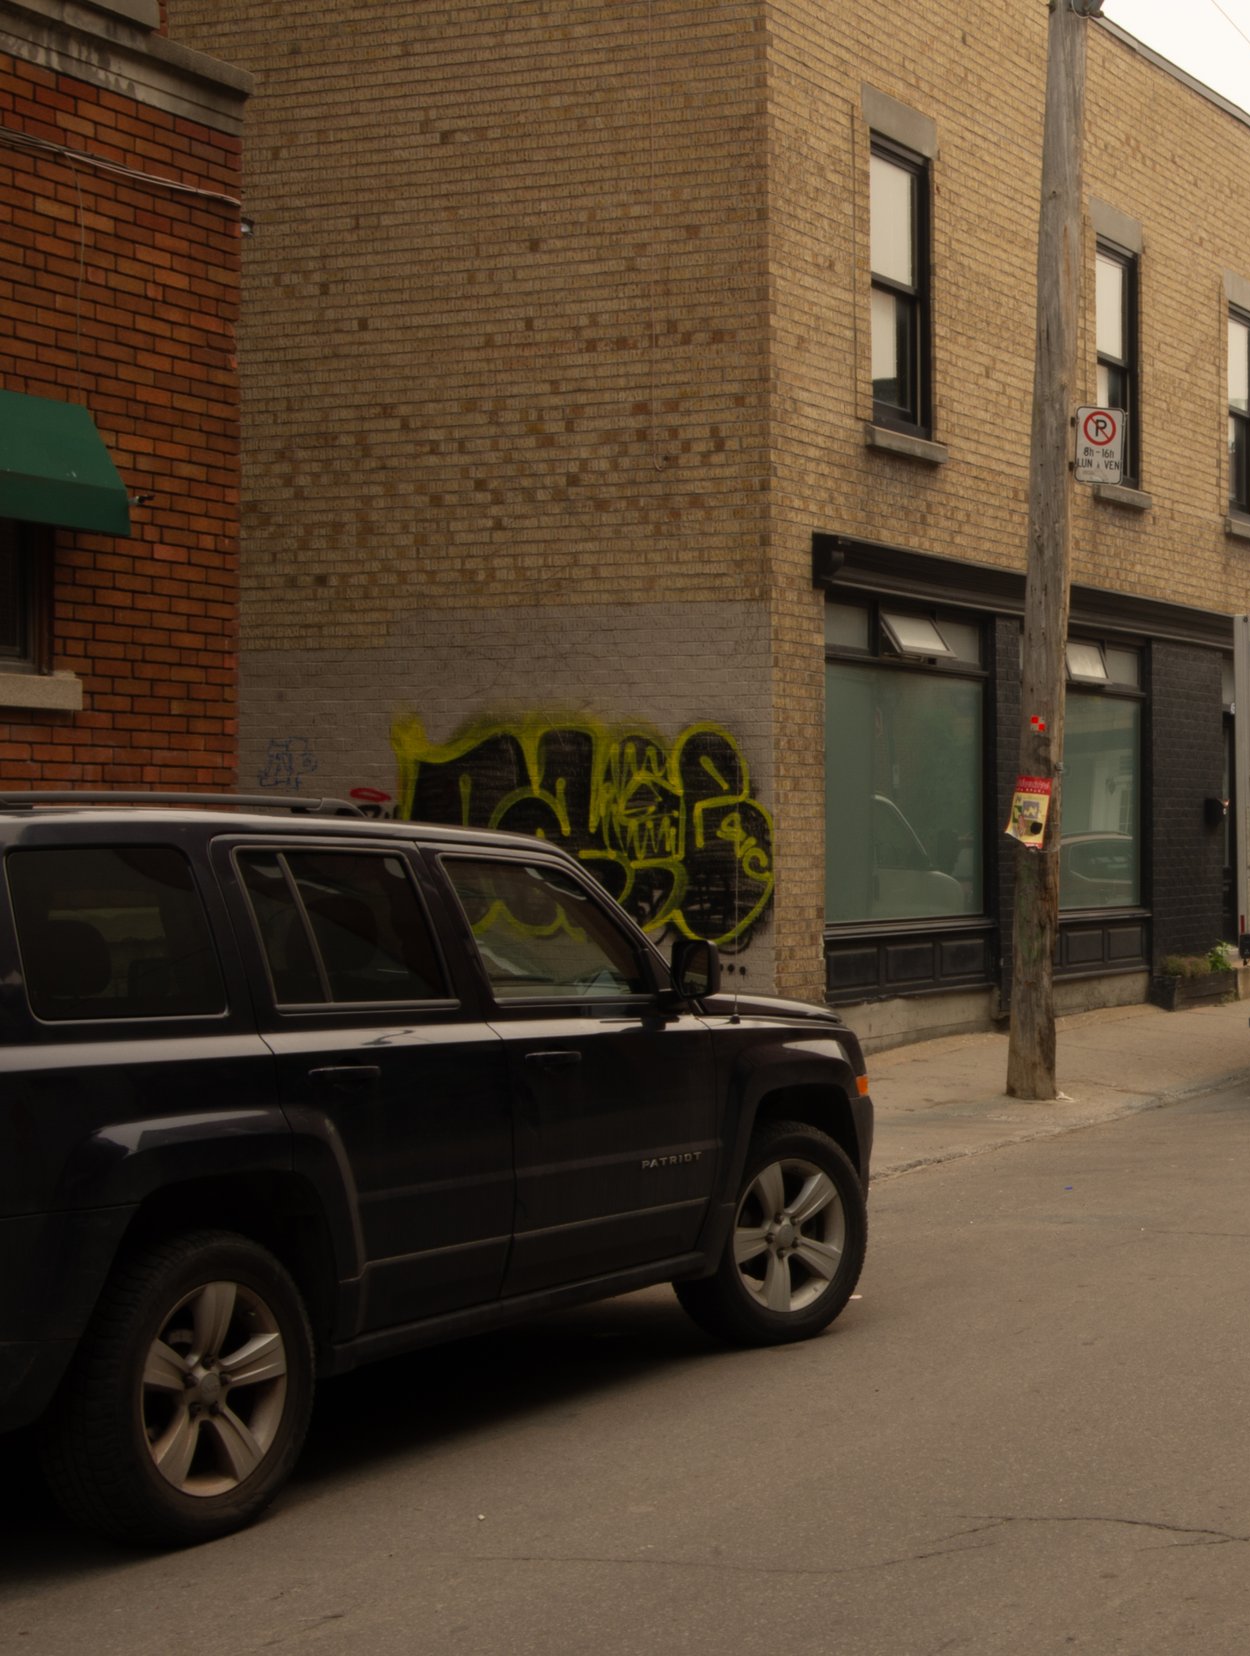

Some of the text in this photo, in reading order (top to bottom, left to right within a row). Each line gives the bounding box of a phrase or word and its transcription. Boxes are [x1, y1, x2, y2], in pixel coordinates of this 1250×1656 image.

[1084, 447, 1094, 457] 8h
[1102, 448, 1115, 459] 16h
[1077, 457, 1093, 468] LUN
[1104, 460, 1120, 471] VEN
[641, 1151, 702, 1169] PATRIOT
